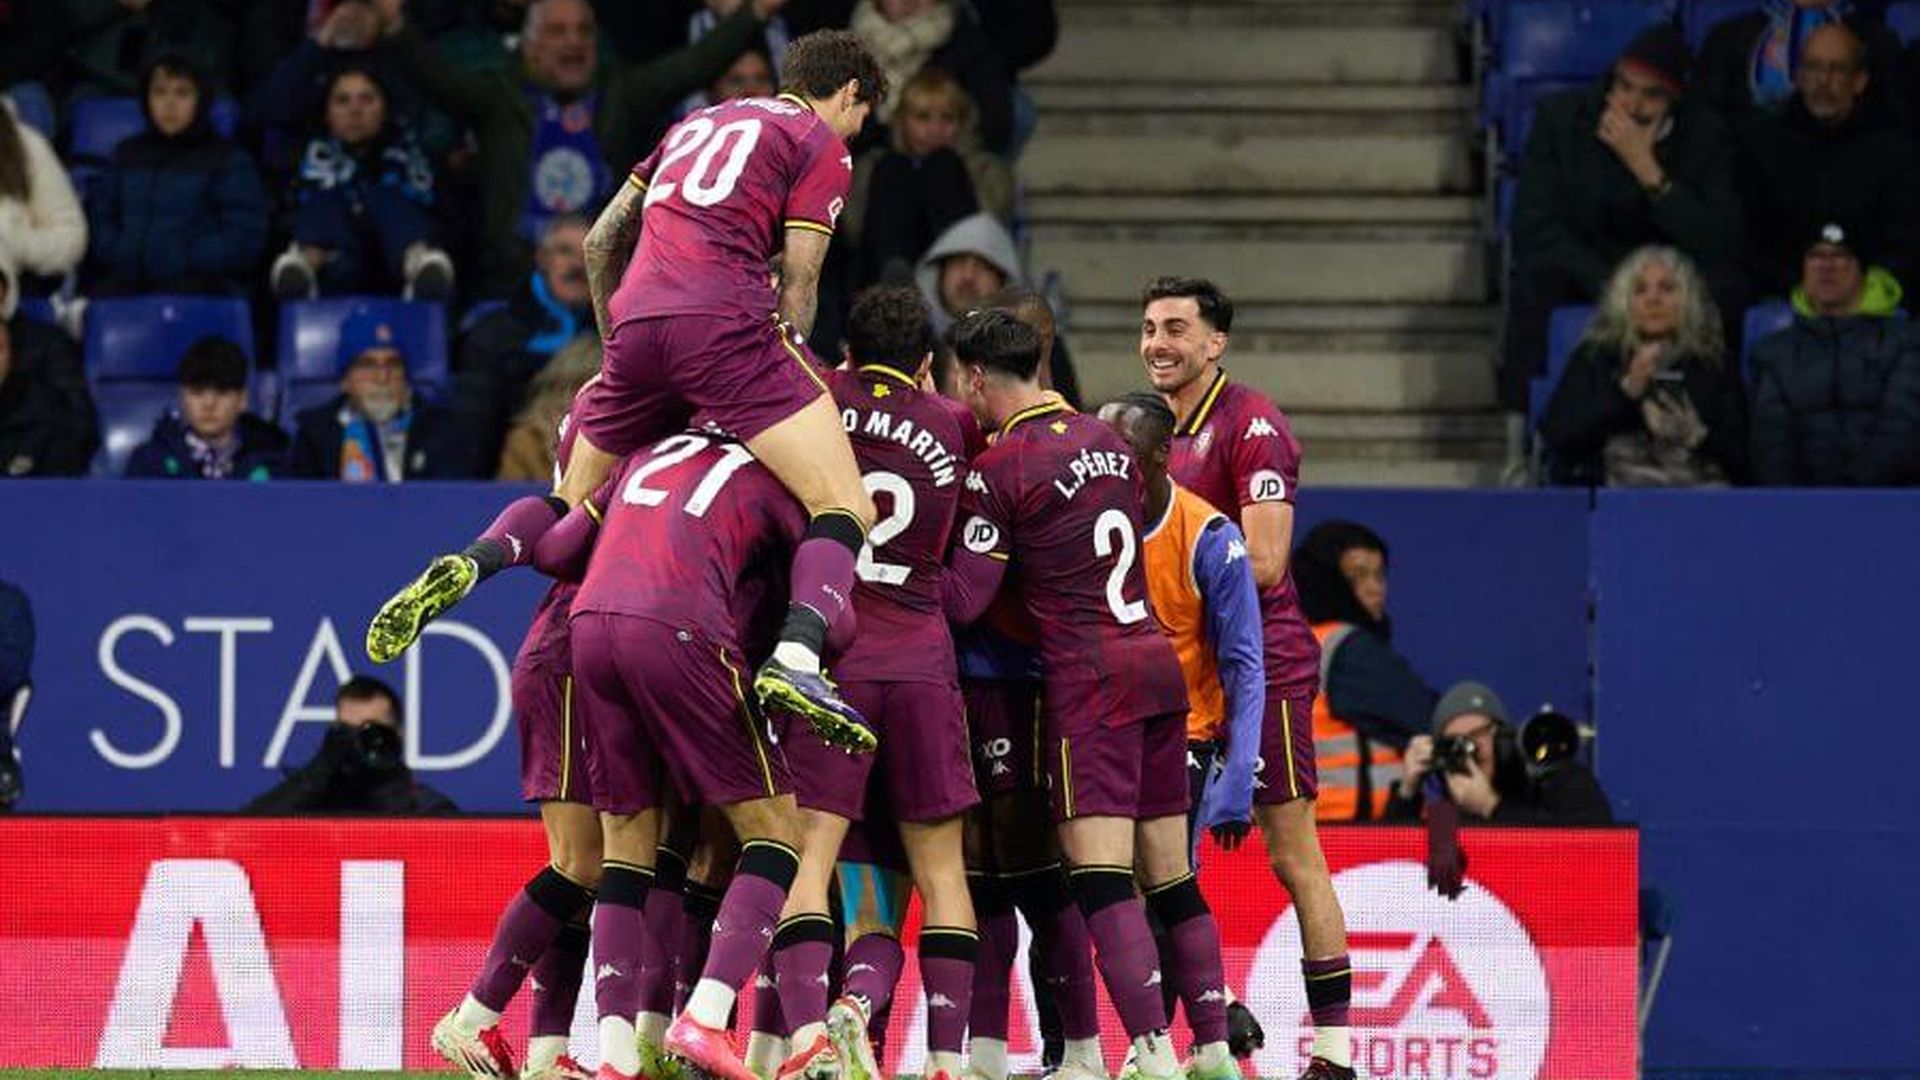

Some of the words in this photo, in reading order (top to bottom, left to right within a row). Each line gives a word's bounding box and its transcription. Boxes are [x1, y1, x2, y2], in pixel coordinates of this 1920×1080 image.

[643, 118, 761, 207] 20
[622, 434, 754, 517] 21
[864, 410, 957, 488] MARTÍN
[1054, 448, 1131, 500] L.PÉREZ
[1256, 479, 1281, 500] JD
[855, 470, 915, 586] 2
[967, 523, 995, 544] JD
[1093, 508, 1149, 625] 2
[90, 614, 513, 771] STAD
[1303, 931, 1495, 1028] EA
